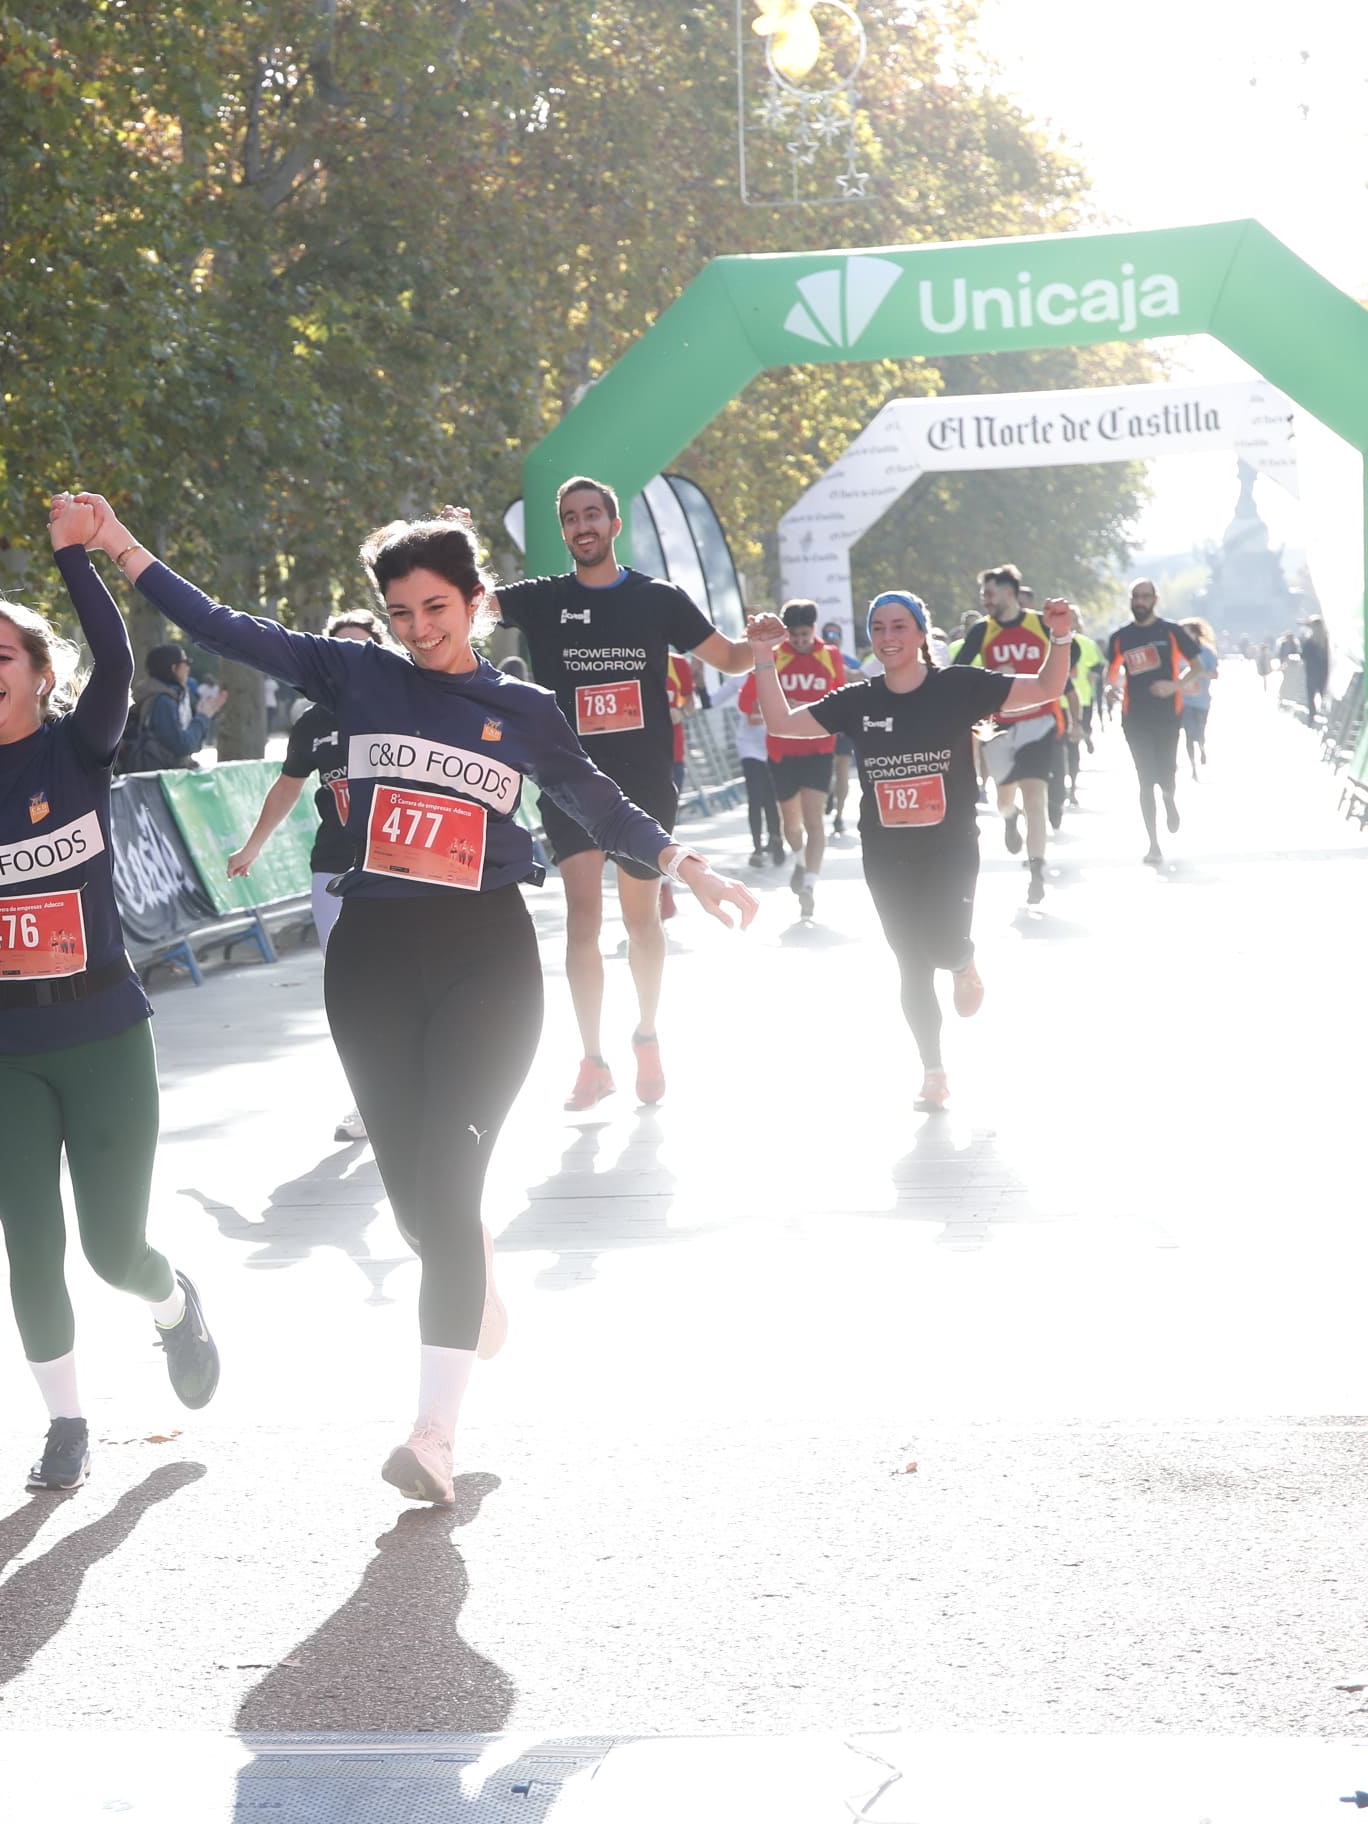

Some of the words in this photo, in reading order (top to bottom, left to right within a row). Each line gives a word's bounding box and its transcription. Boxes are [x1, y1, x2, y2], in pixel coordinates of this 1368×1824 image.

[919, 263, 1180, 333] Unicaja
[927, 417, 967, 451] El
[973, 415, 1054, 450] Norte
[1060, 413, 1091, 443] de
[1097, 401, 1222, 441] Castilla
[563, 647, 646, 659] #POWERING
[993, 643, 1040, 662] UVa
[564, 660, 647, 671] TOMORROW
[783, 673, 826, 691] UVa
[584, 693, 617, 717] 783
[369, 743, 416, 768] C&D
[426, 750, 512, 800] FOODS
[866, 761, 951, 778] TOMORROW
[425, 803, 452, 812] empresas
[884, 788, 919, 810] 782
[382, 807, 443, 848] 477
[17, 904, 42, 912] empresas
